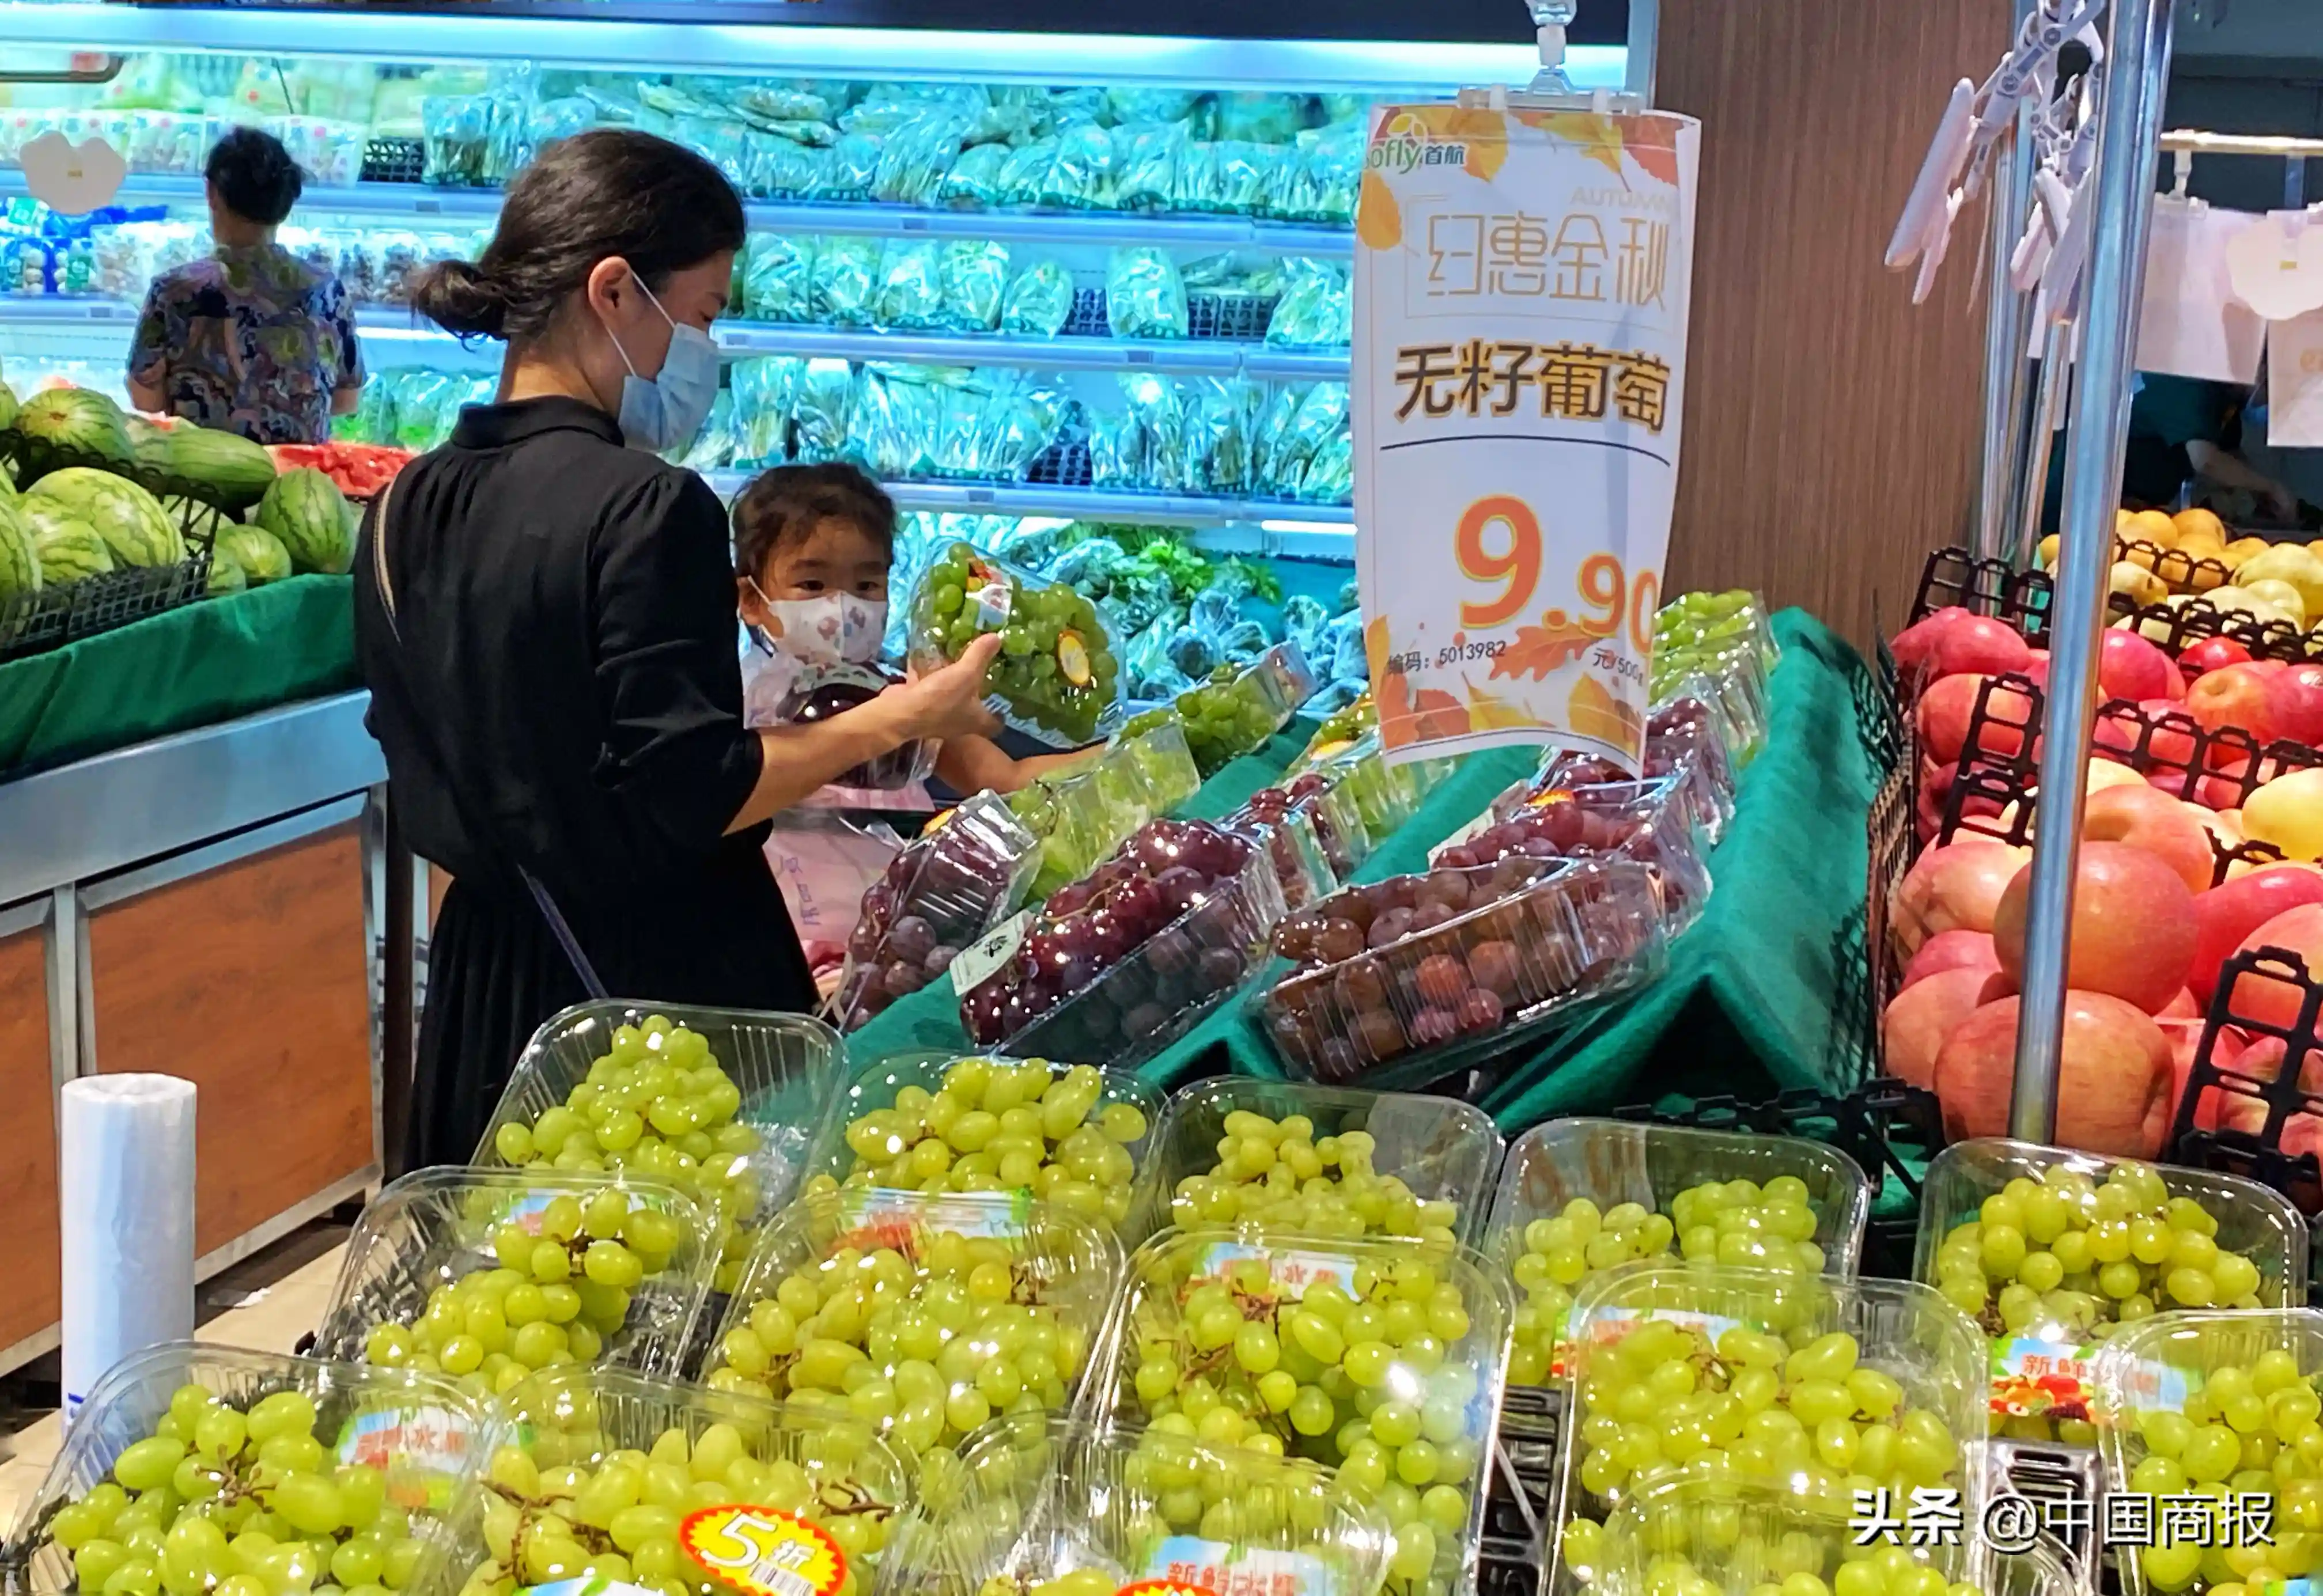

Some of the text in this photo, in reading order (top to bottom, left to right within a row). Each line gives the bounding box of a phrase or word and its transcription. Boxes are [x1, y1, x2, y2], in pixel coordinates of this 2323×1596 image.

[1365, 138, 1422, 175] ofly
[1427, 210, 1669, 311] 约惠金秋
[1394, 339, 1670, 434] 无籽葡萄
[1455, 494, 1658, 657] 9.90
